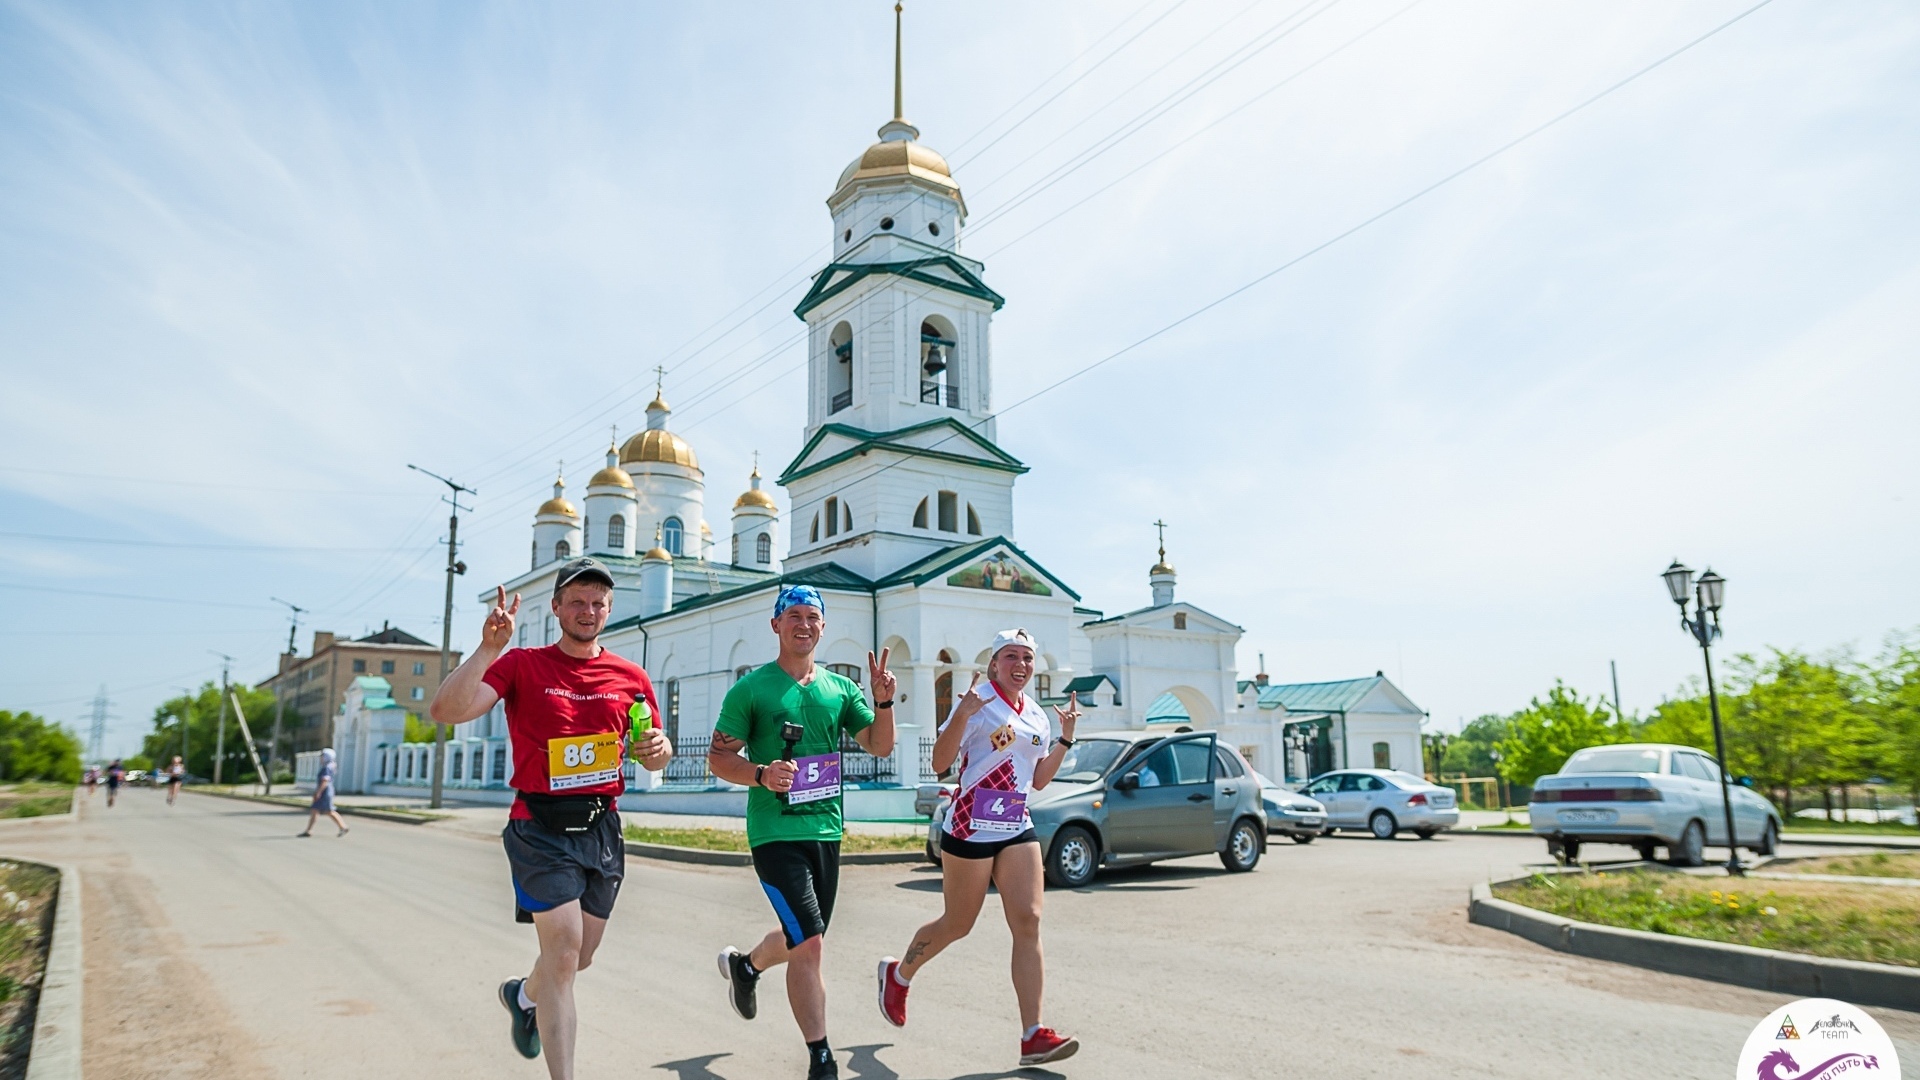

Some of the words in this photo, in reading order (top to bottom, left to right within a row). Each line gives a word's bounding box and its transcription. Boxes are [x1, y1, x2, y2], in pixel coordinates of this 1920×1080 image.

[545, 688, 566, 696] FROM
[565, 691, 586, 700] RUSSIA
[603, 692, 620, 700] LOVE
[564, 742, 596, 768] 86
[807, 762, 820, 783] 5
[991, 797, 1006, 816] 4
